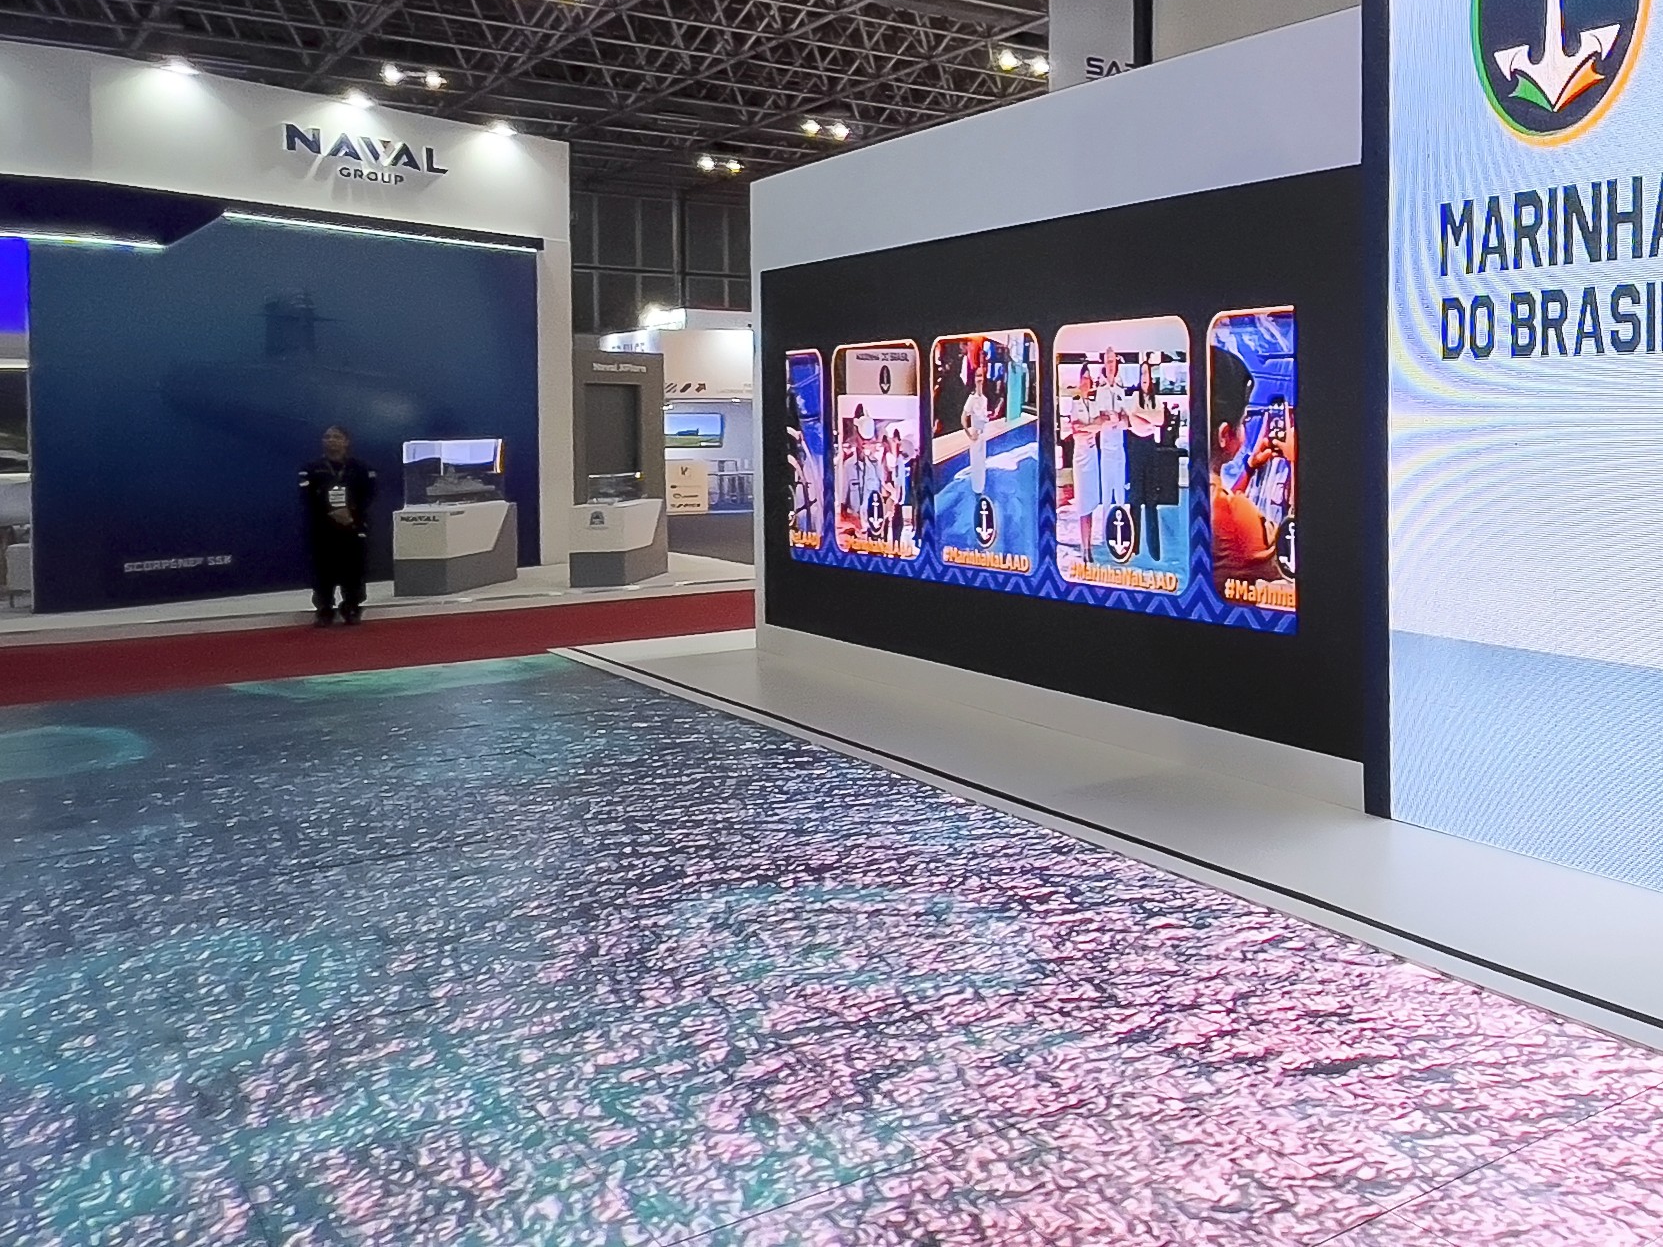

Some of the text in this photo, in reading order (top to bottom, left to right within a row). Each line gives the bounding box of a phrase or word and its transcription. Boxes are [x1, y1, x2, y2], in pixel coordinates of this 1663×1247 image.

[284, 123, 449, 175] NAVAL
[339, 166, 405, 186] GROUP
[1442, 295, 1494, 361] DO
[1070, 561, 1179, 593] #MarinhaNaLAAD
